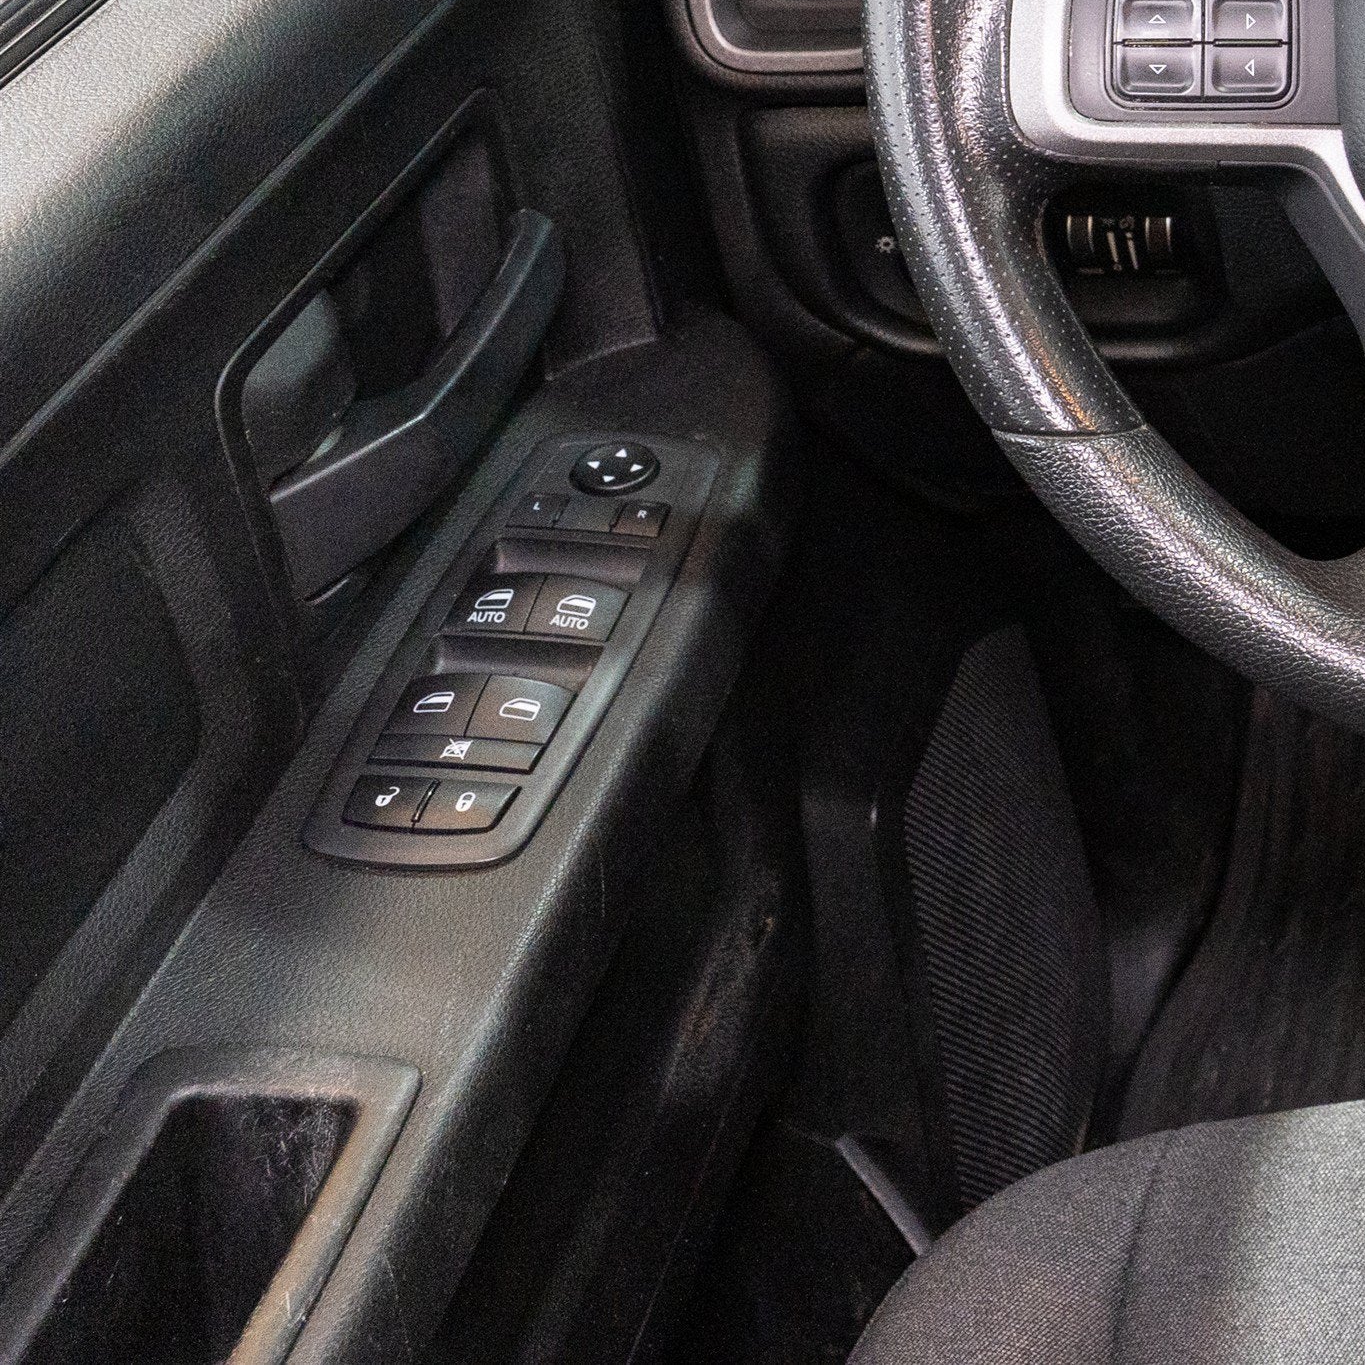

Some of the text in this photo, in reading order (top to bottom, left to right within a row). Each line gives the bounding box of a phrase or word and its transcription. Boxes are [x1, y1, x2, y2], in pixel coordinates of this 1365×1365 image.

[533, 502, 541, 511] L
[637, 510, 647, 518] R
[467, 611, 506, 623] AUTO
[549, 614, 589, 630] AUTO
